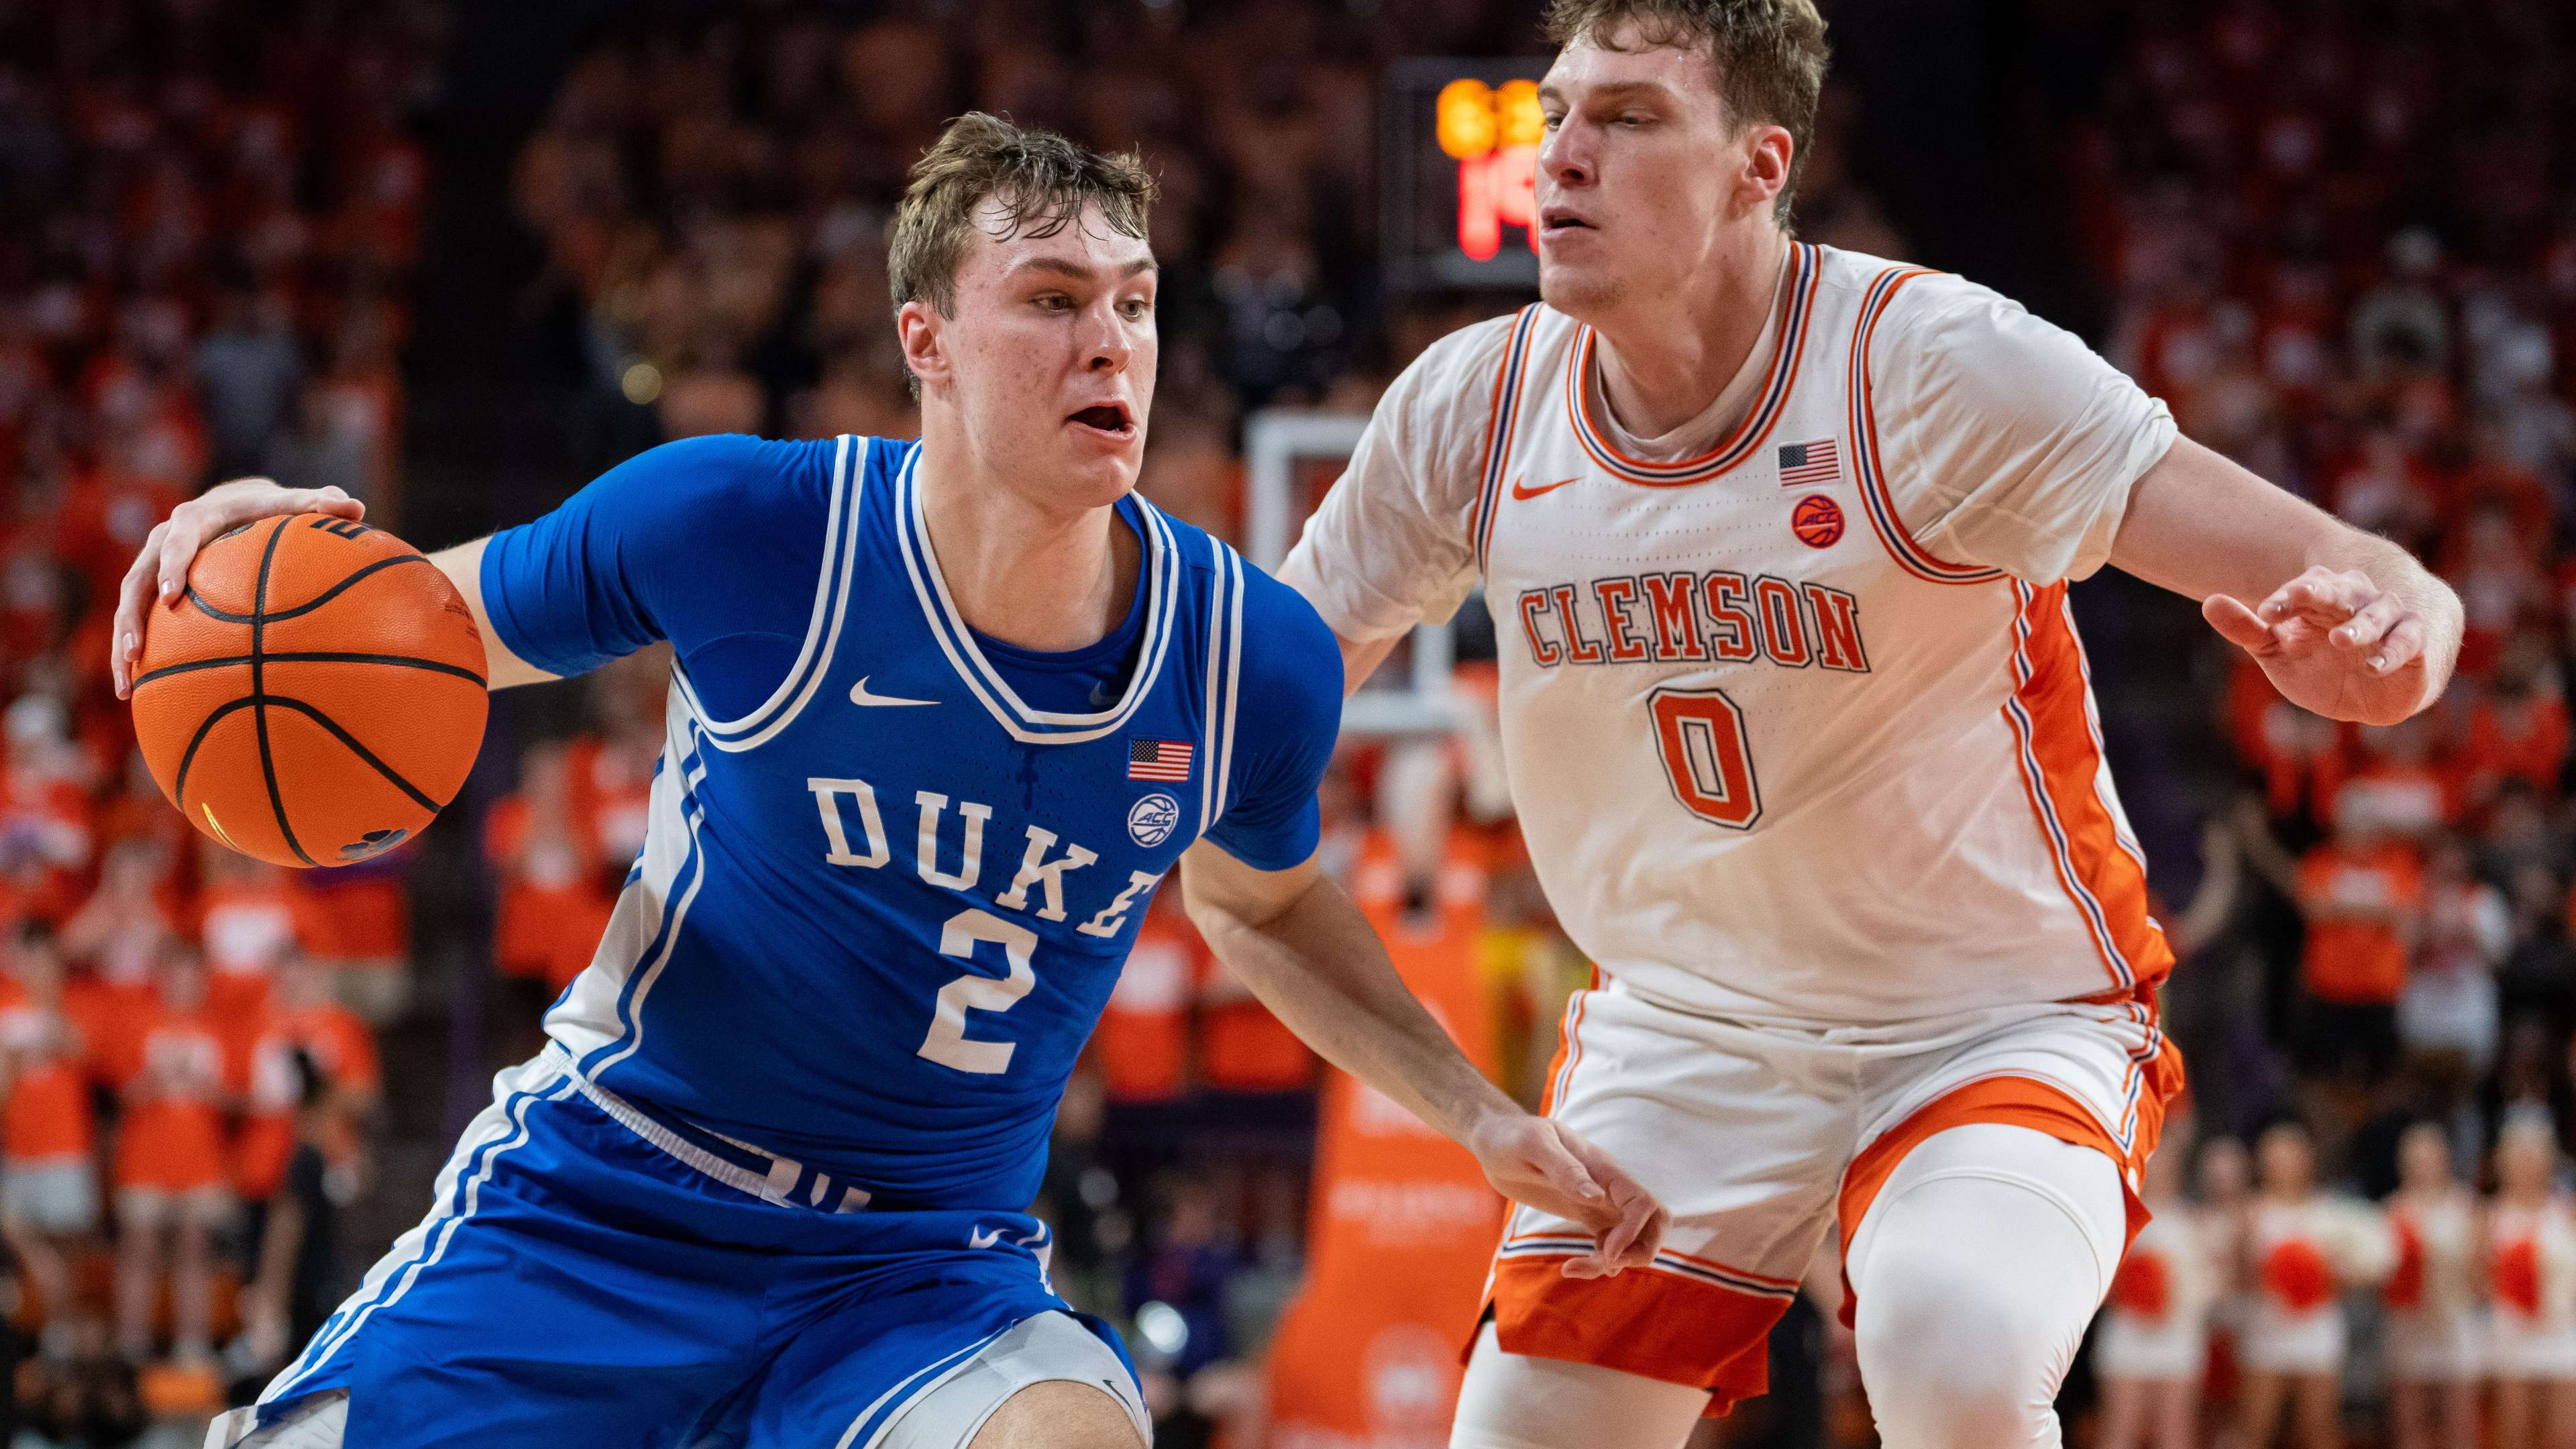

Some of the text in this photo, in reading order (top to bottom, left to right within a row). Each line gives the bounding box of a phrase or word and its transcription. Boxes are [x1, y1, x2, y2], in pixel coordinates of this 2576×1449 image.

[1801, 511, 1839, 526] ACC
[1517, 570, 1872, 673] CLEMSON
[1136, 811, 1176, 827] ACC
[1647, 686, 1763, 830] 0
[807, 777, 1164, 938] DUKE
[916, 908, 1039, 1075] 2
